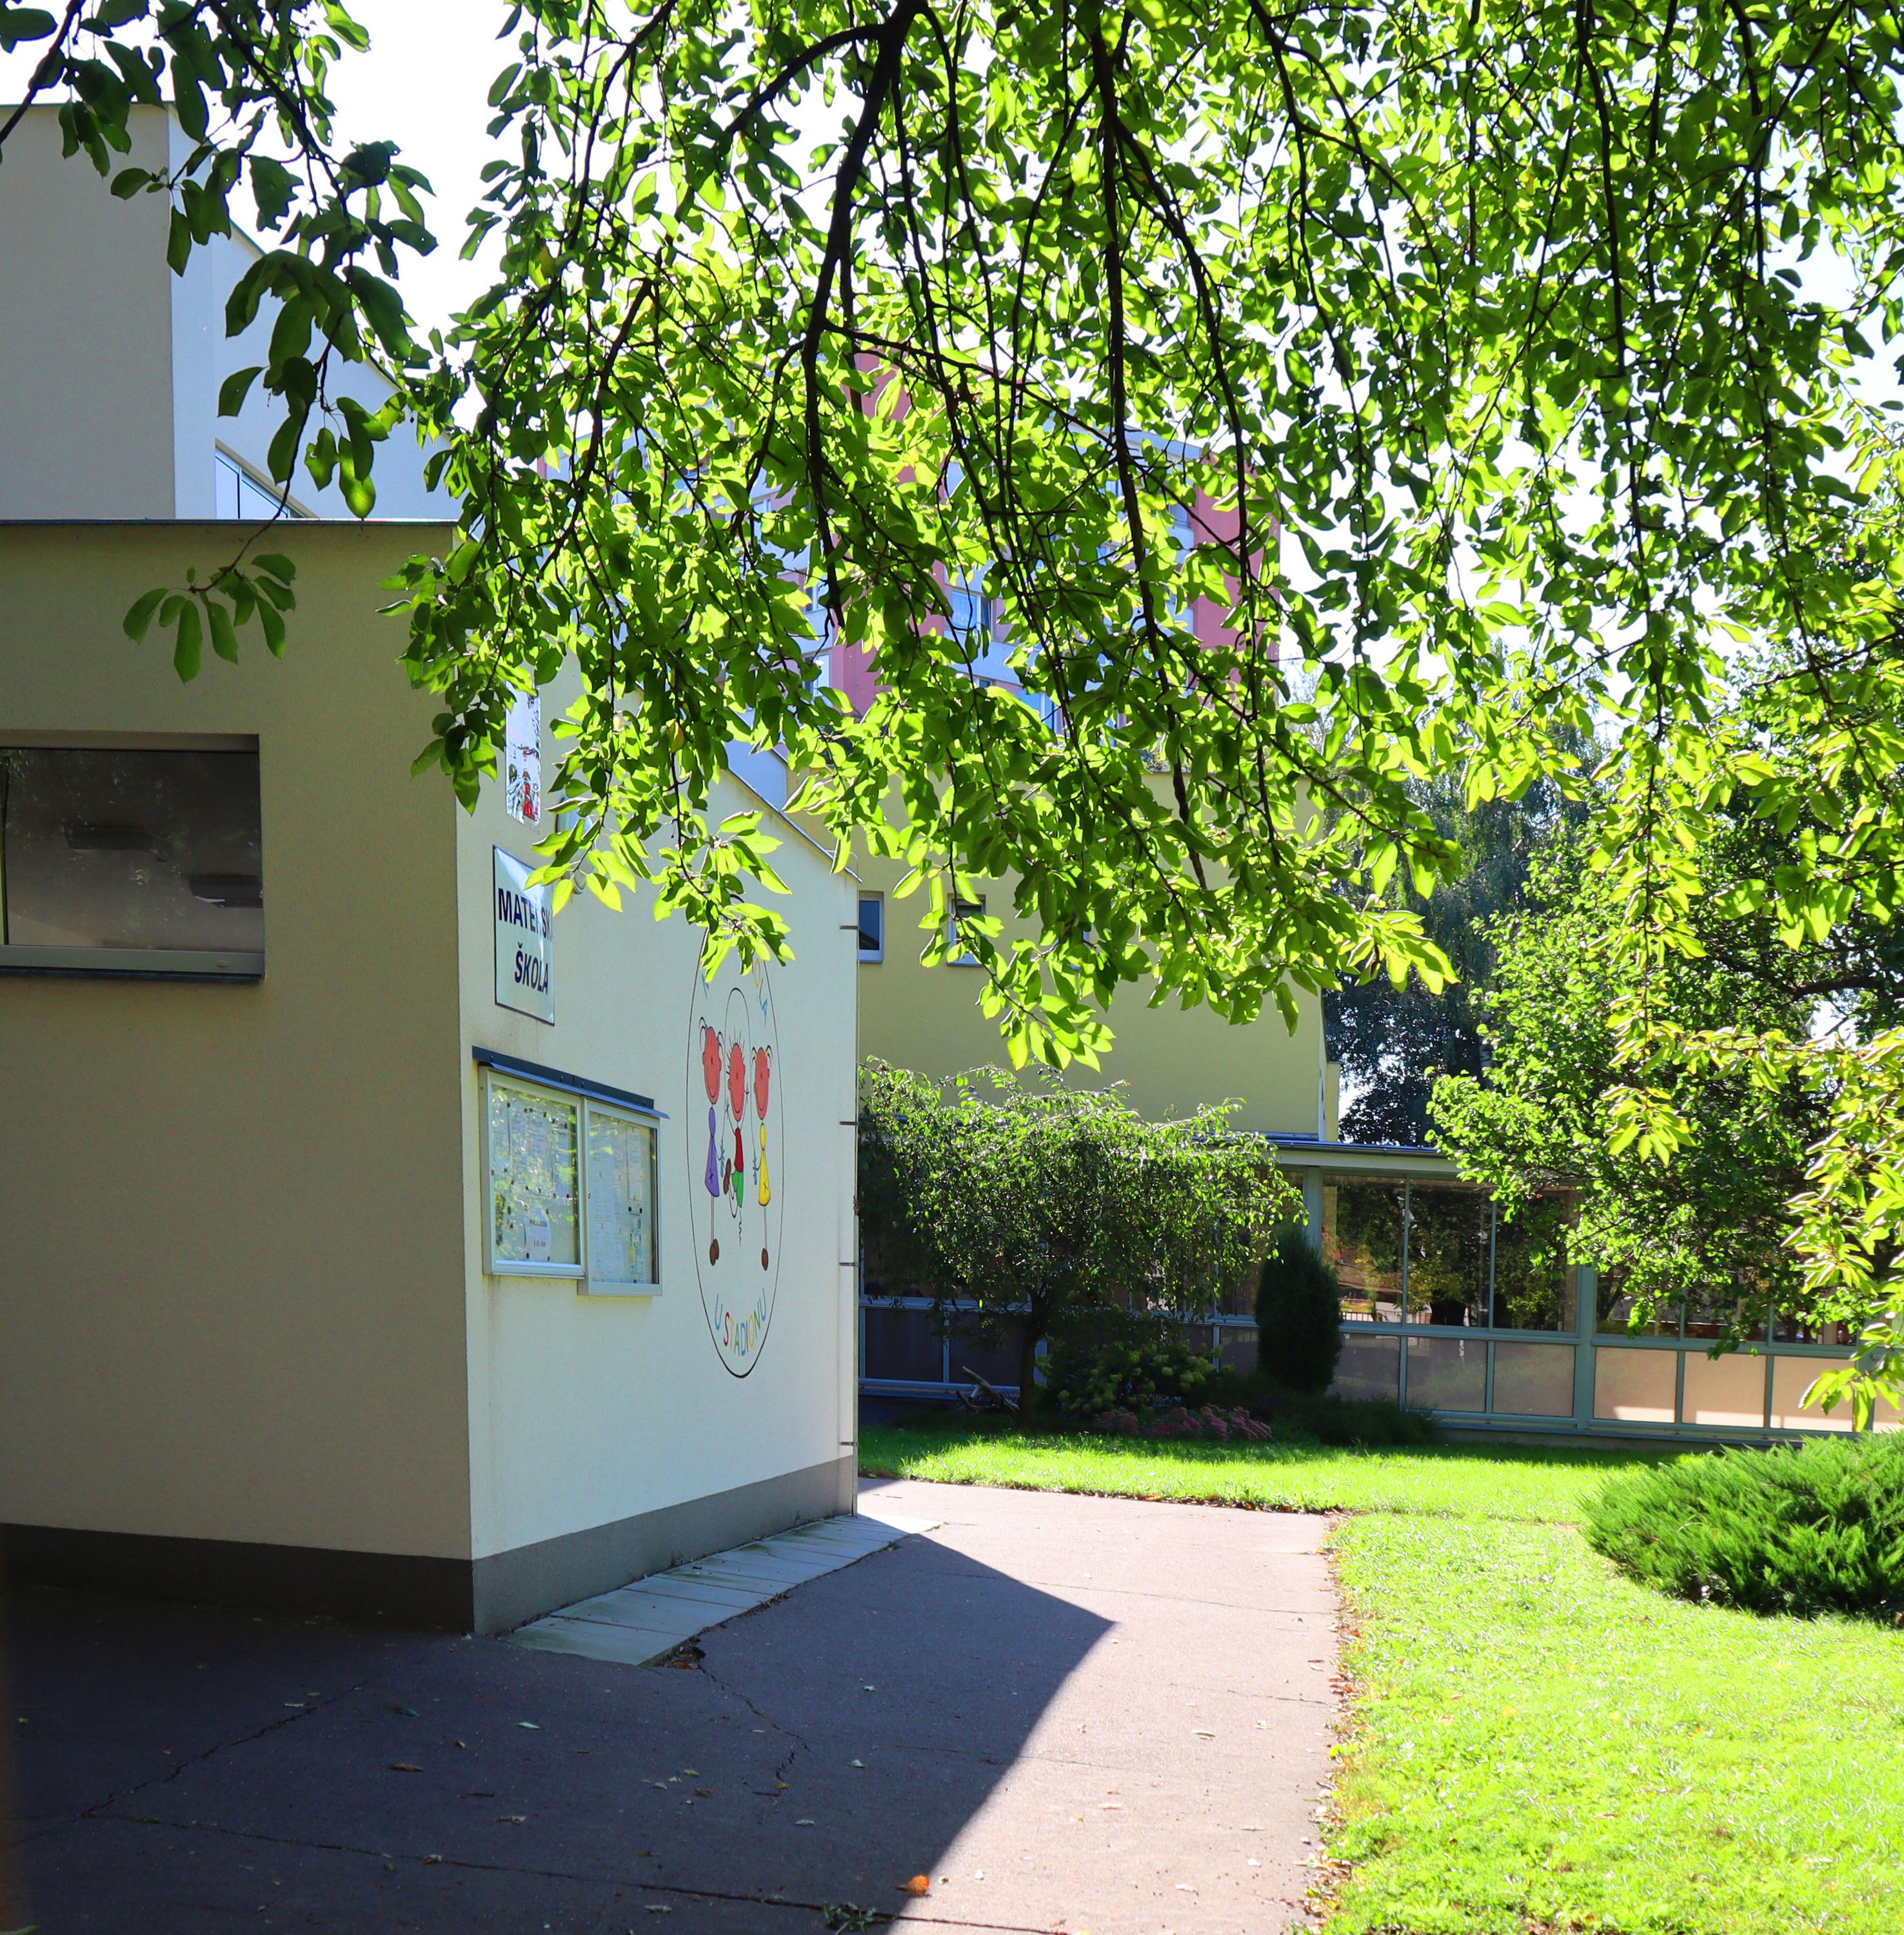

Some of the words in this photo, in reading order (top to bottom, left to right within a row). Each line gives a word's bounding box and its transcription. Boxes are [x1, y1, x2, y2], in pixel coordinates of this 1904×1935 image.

[498, 888, 553, 942] MATEŘSK
[514, 942, 548, 995] ŠKOLA
[714, 1293, 724, 1331] U
[723, 1287, 767, 1357] STADIONU
